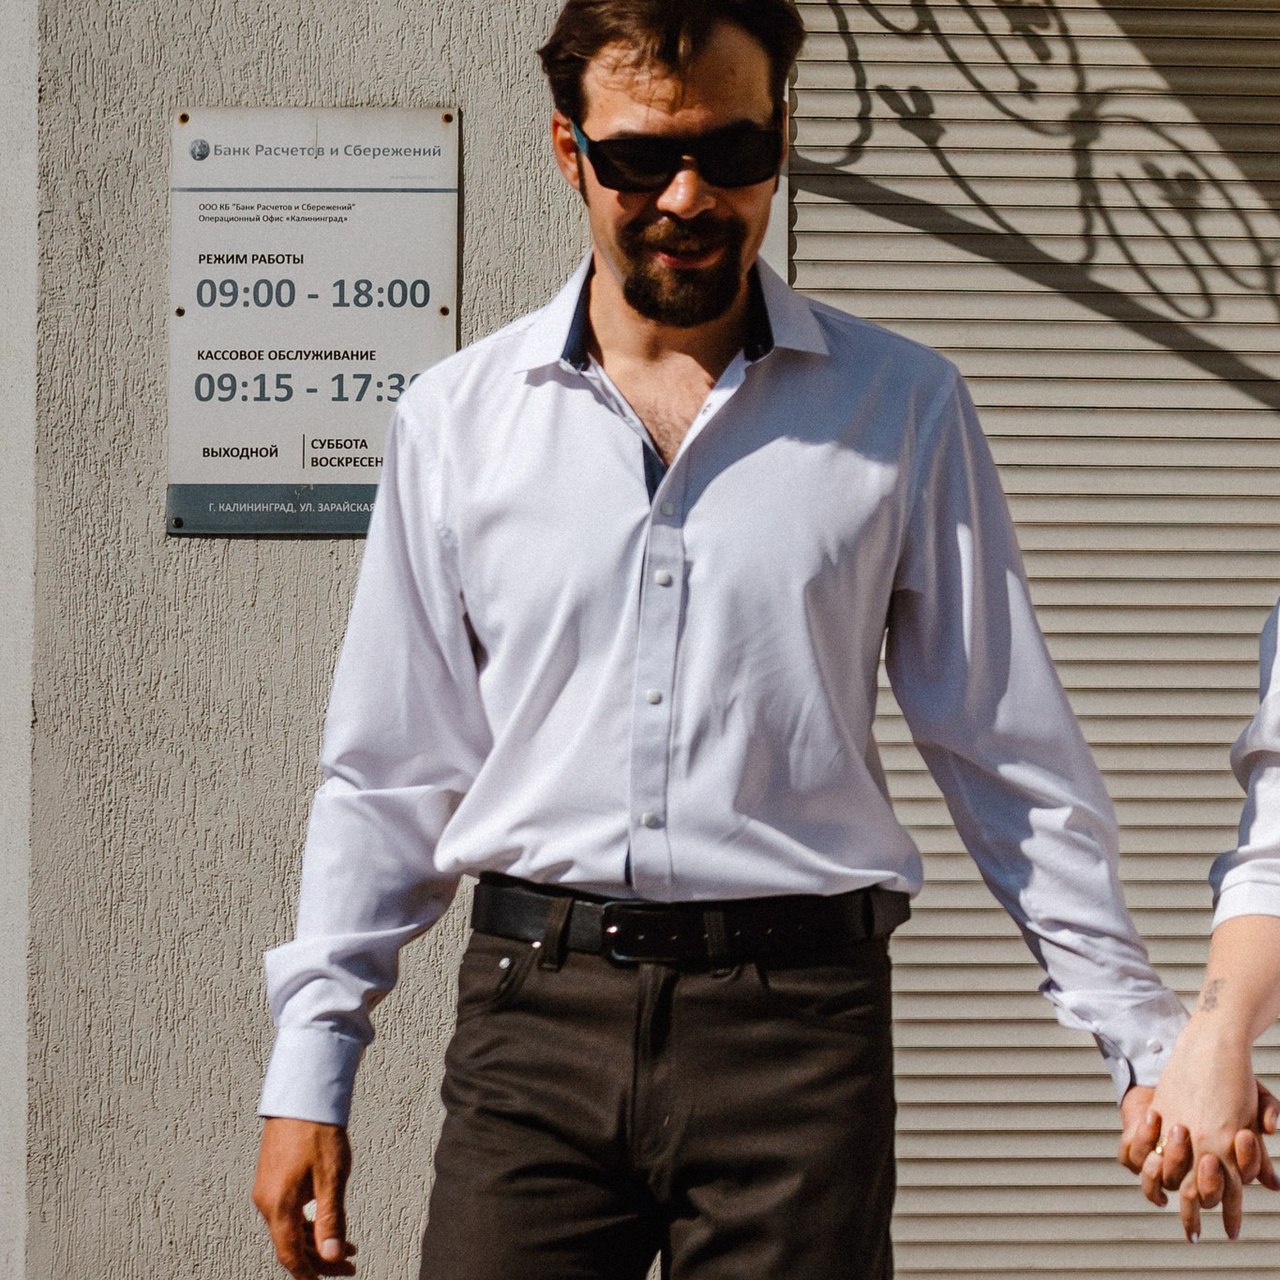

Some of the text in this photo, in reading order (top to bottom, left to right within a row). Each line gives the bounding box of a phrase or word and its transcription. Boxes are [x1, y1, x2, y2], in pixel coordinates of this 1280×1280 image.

[214, 143, 442, 158] Банк Расчетов и Сбережений
[198, 203, 218, 211] ООО
[219, 203, 230, 211] КБ
[256, 203, 293, 212] Расчетов
[198, 214, 261, 223] Операционный
[262, 214, 284, 223] Офис
[198, 253, 304, 265] РЕЖИМ РАБОТЫ
[196, 278, 296, 308] 09:00
[332, 278, 430, 308] 18:00
[197, 349, 376, 361] КАССОВОЕ ОБСЛУЖИВАНИЕ
[194, 373, 293, 402] 09:15
[331, 373, 421, 402] 17:3
[310, 438, 368, 450] СУББОТА
[202, 444, 278, 459] ВЫХОДНОЙ
[209, 503, 216, 512] Г.
[218, 502, 297, 513] КАЛИНИНГРАД,
[300, 502, 315, 512] УЛ.
